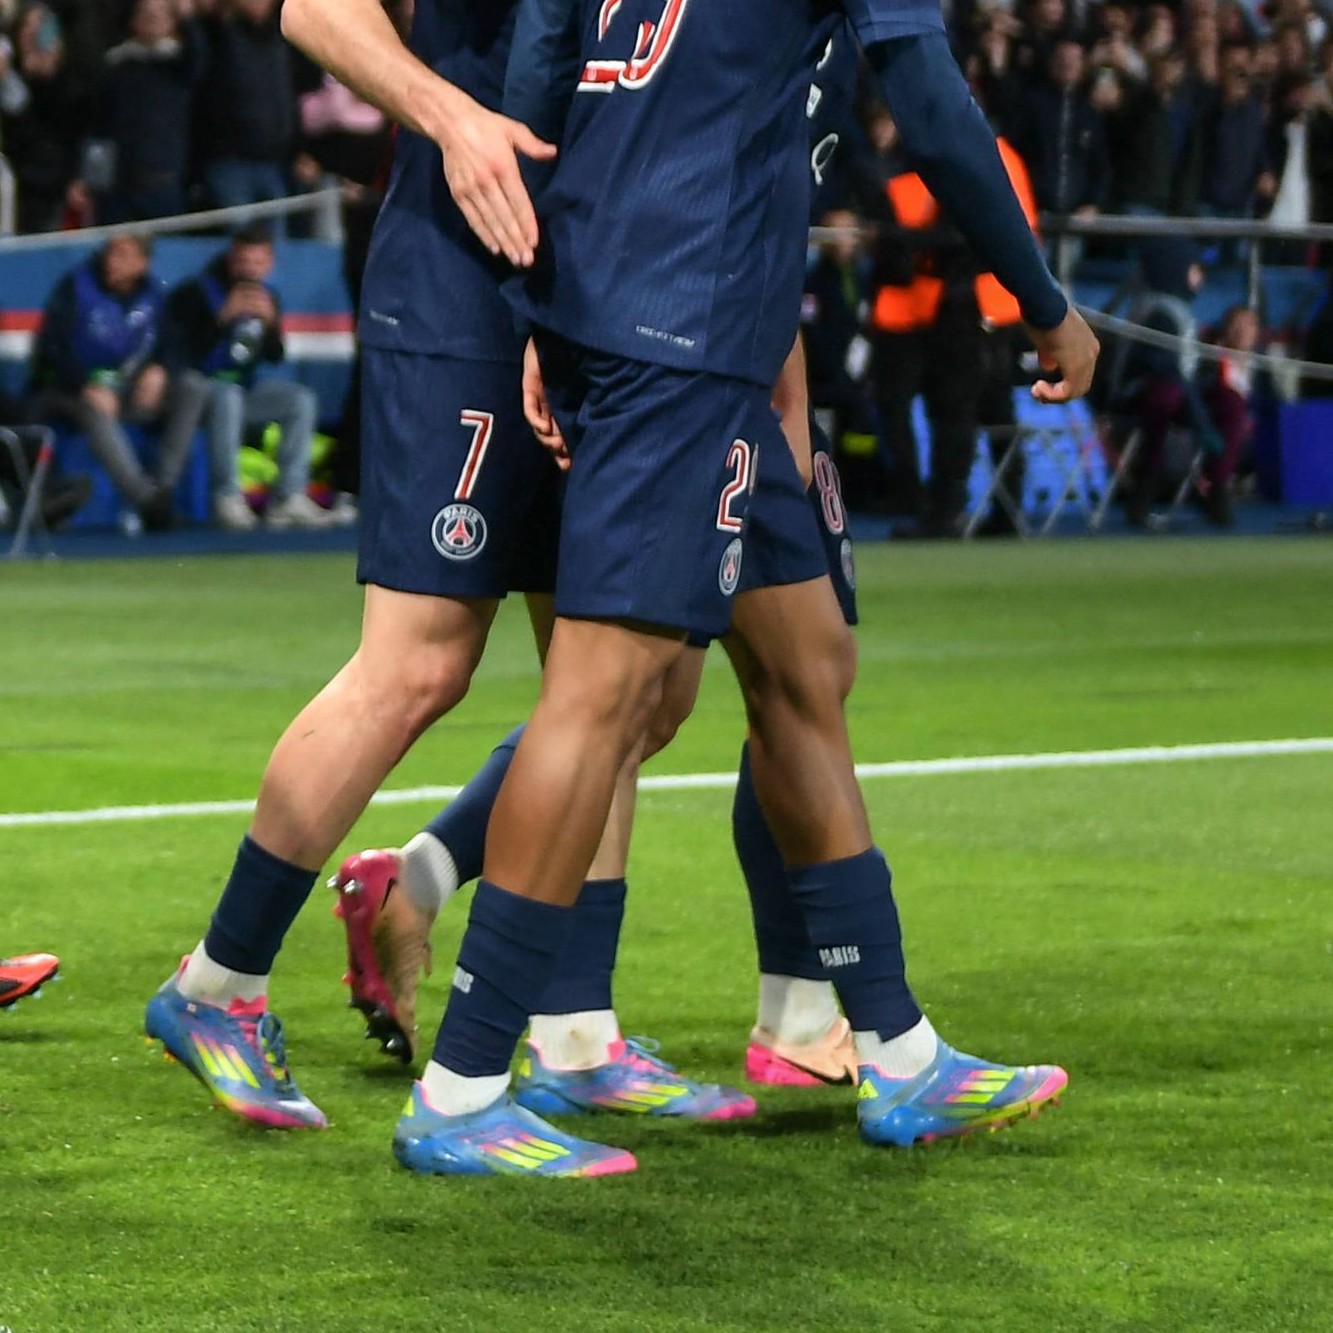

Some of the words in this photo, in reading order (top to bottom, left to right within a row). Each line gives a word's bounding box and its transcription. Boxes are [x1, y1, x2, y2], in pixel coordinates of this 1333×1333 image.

[454, 409, 494, 501] 7
[716, 438, 759, 534] 2
[443, 507, 479, 524] PARIS
